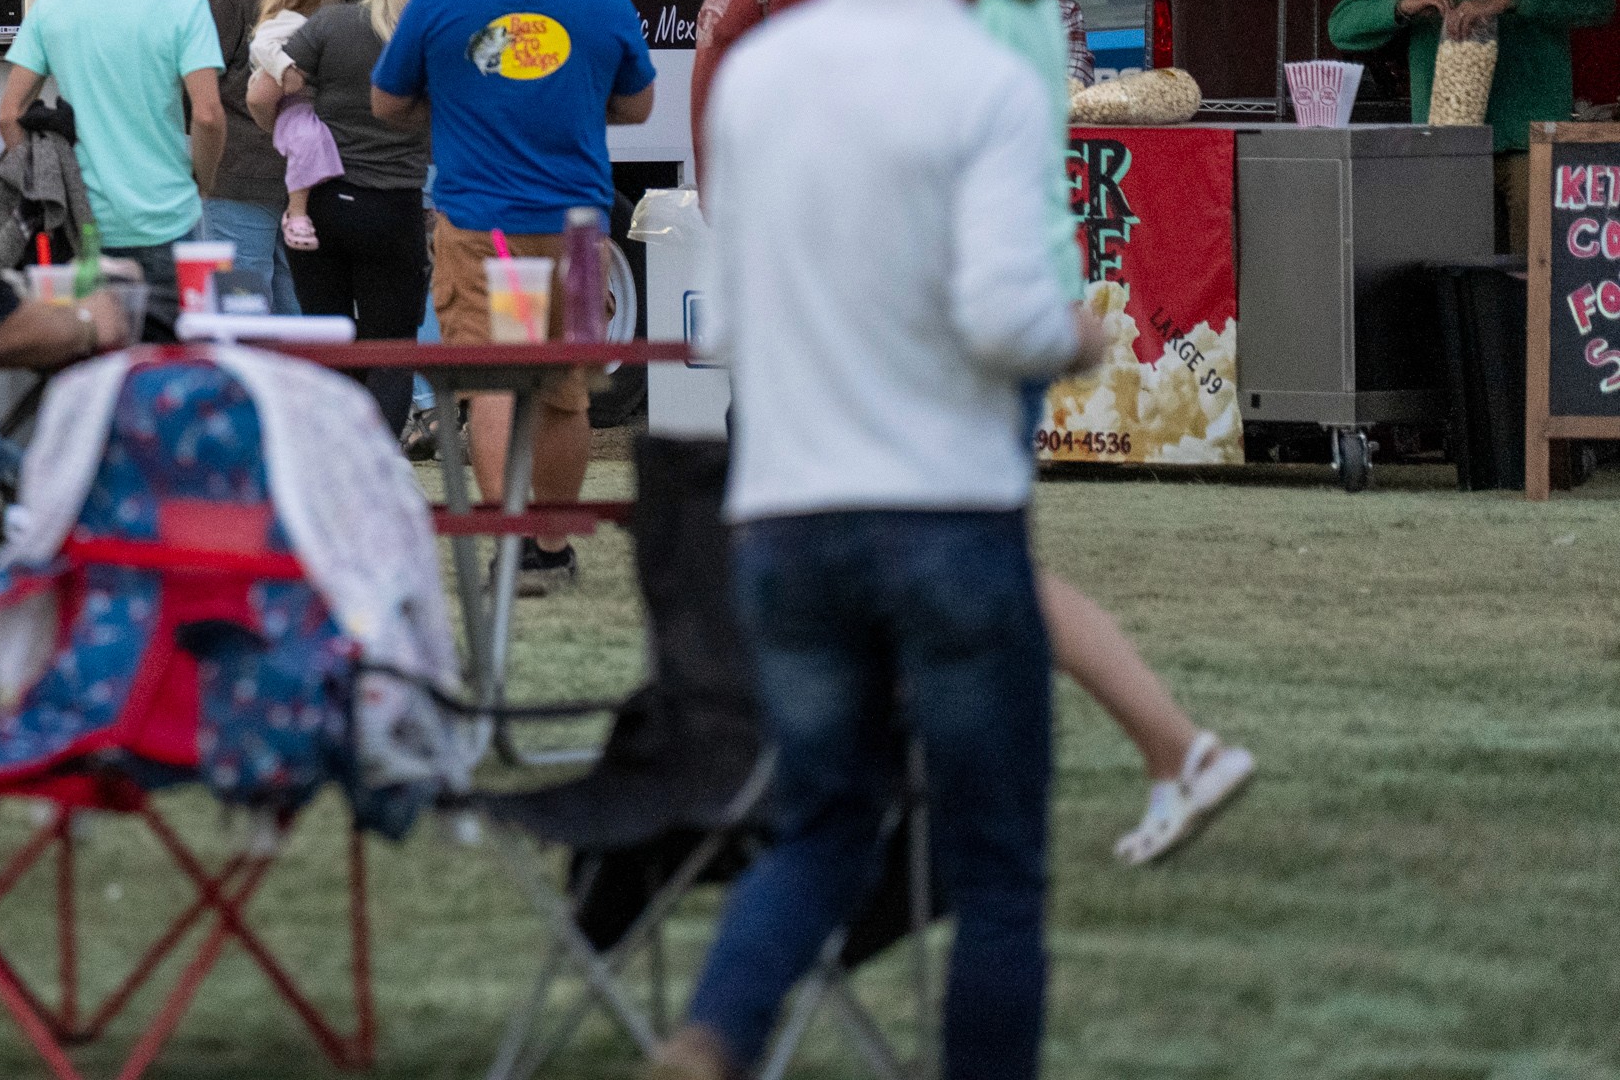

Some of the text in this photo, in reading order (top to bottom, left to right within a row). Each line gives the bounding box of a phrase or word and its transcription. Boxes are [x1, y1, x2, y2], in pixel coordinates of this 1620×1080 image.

[510, 16, 547, 35] Bass
[511, 36, 540, 57] Pro
[1150, 307, 1224, 395] LARGE $9
